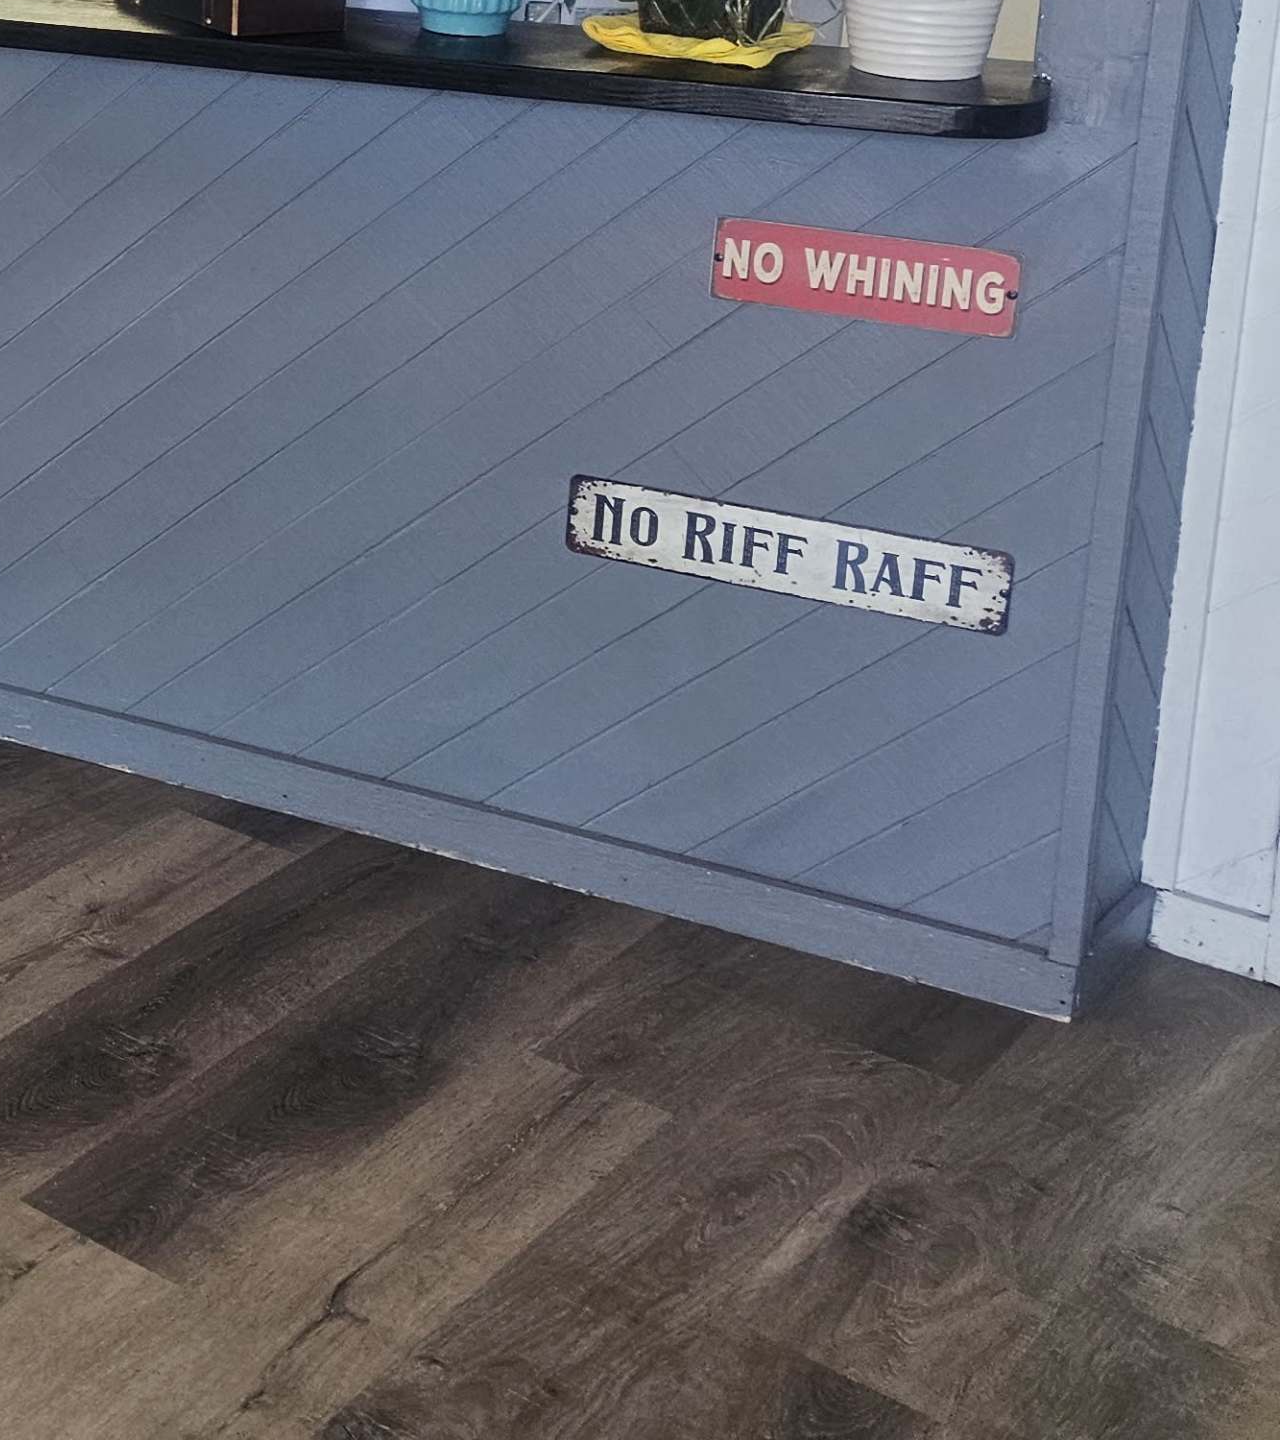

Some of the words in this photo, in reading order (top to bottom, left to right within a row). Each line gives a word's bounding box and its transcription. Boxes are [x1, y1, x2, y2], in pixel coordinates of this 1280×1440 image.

[722, 238, 784, 284] NO
[805, 247, 1006, 315] WHINING
[590, 494, 659, 548] NO
[681, 511, 809, 576] RIFF
[832, 538, 984, 609] RAFF
